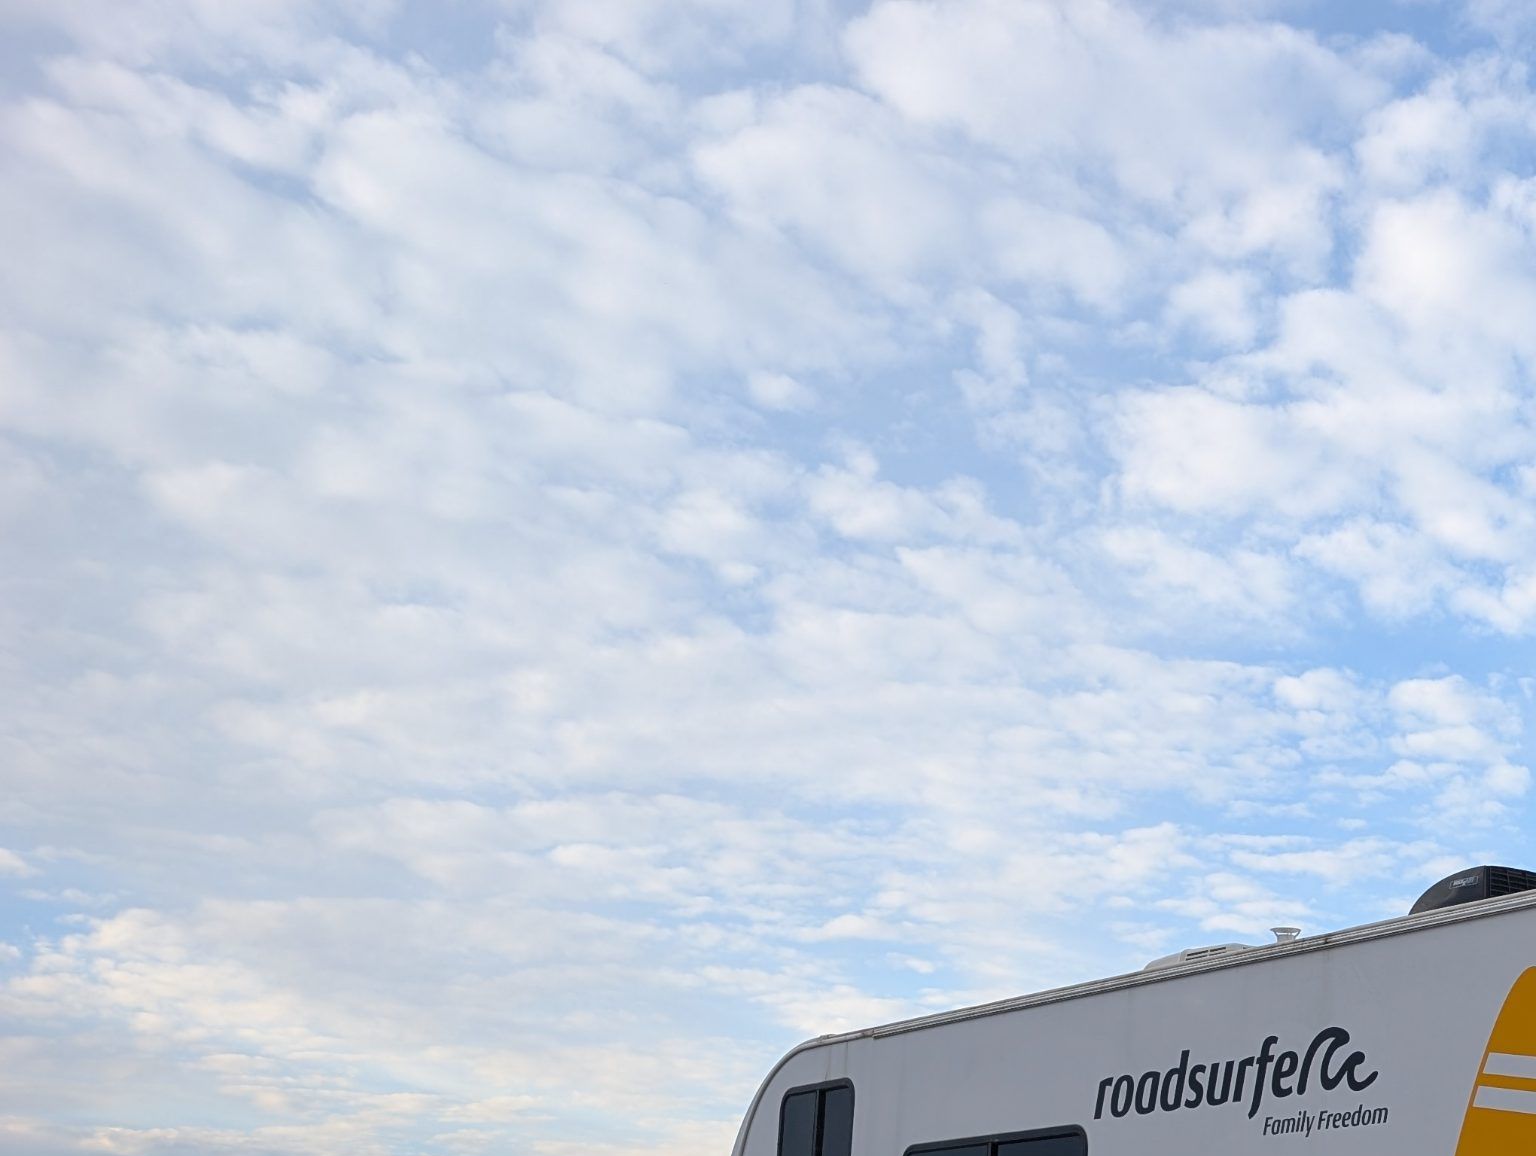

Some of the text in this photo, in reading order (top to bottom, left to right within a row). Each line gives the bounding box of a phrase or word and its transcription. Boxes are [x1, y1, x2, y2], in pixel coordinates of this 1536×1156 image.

[1093, 1026, 1379, 1120] roadsurfer
[1263, 1104, 1389, 1138] Family Freedom
